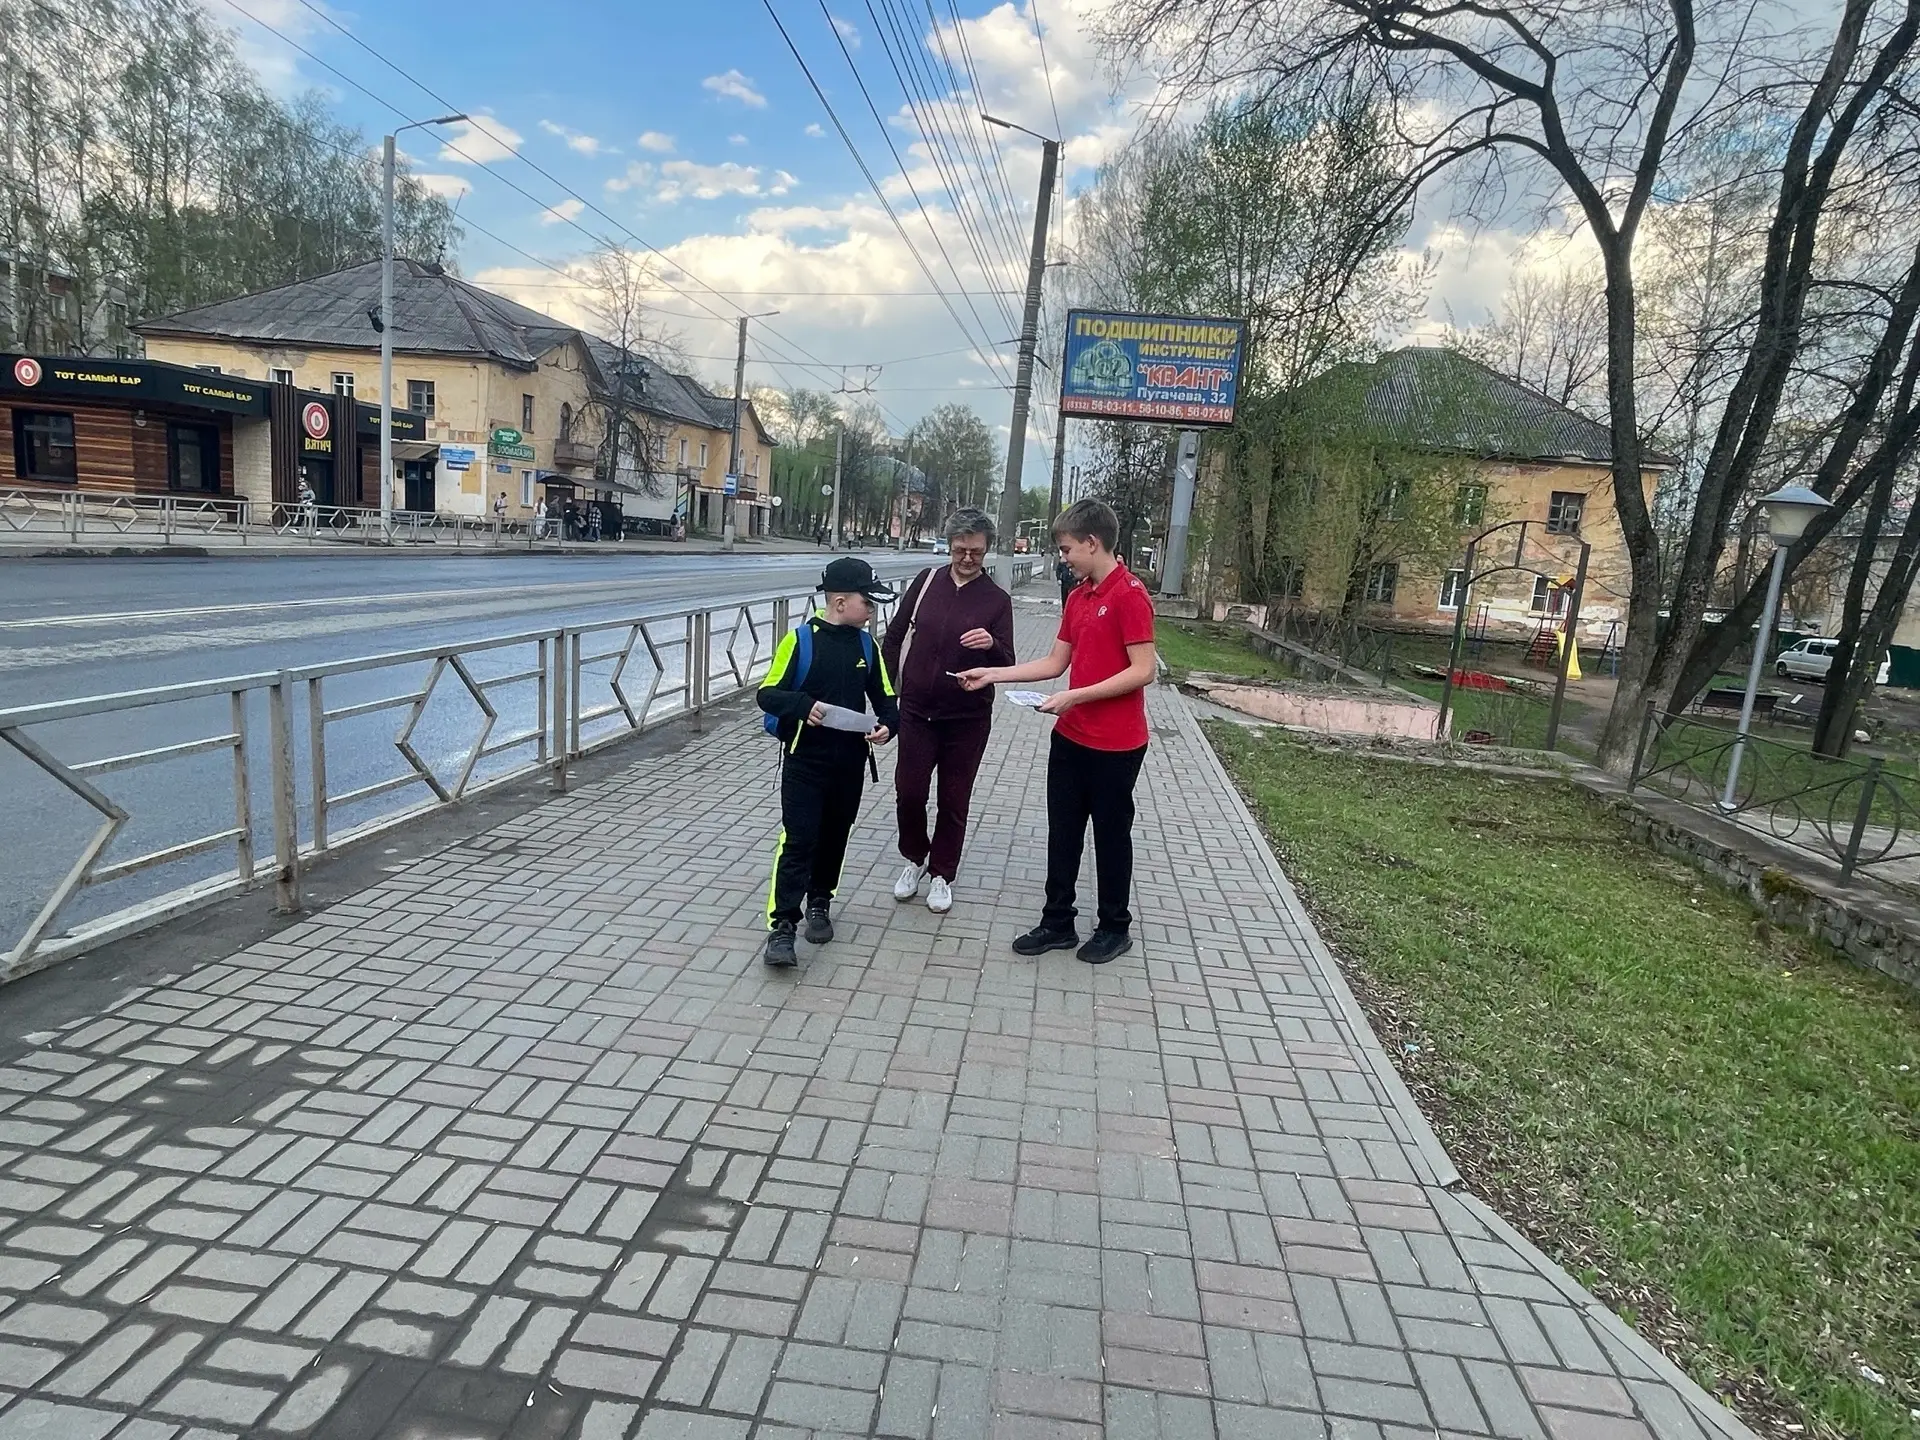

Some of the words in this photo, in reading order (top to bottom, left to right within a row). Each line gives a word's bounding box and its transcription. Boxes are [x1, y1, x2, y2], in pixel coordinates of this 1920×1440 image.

[1075, 318, 1238, 345] ПОДШИПНИКИ
[1139, 343, 1235, 360] ИНСТРУМЕНТ
[54, 371, 75, 380] ТОТ
[77, 373, 118, 383] САМЫЙ
[119, 376, 141, 385] БАР
[183, 383, 201, 393] ТОТ
[202, 387, 235, 399] САМЫЙ
[235, 393, 253, 402] БАР
[1136, 386, 1206, 404] Пугачева,
[1210, 391, 1227, 404] 32
[369, 416, 381, 424] ТОТ
[1187, 406, 1230, 420] 56-07-10
[305, 438, 332, 453] ВЯТИЧ
